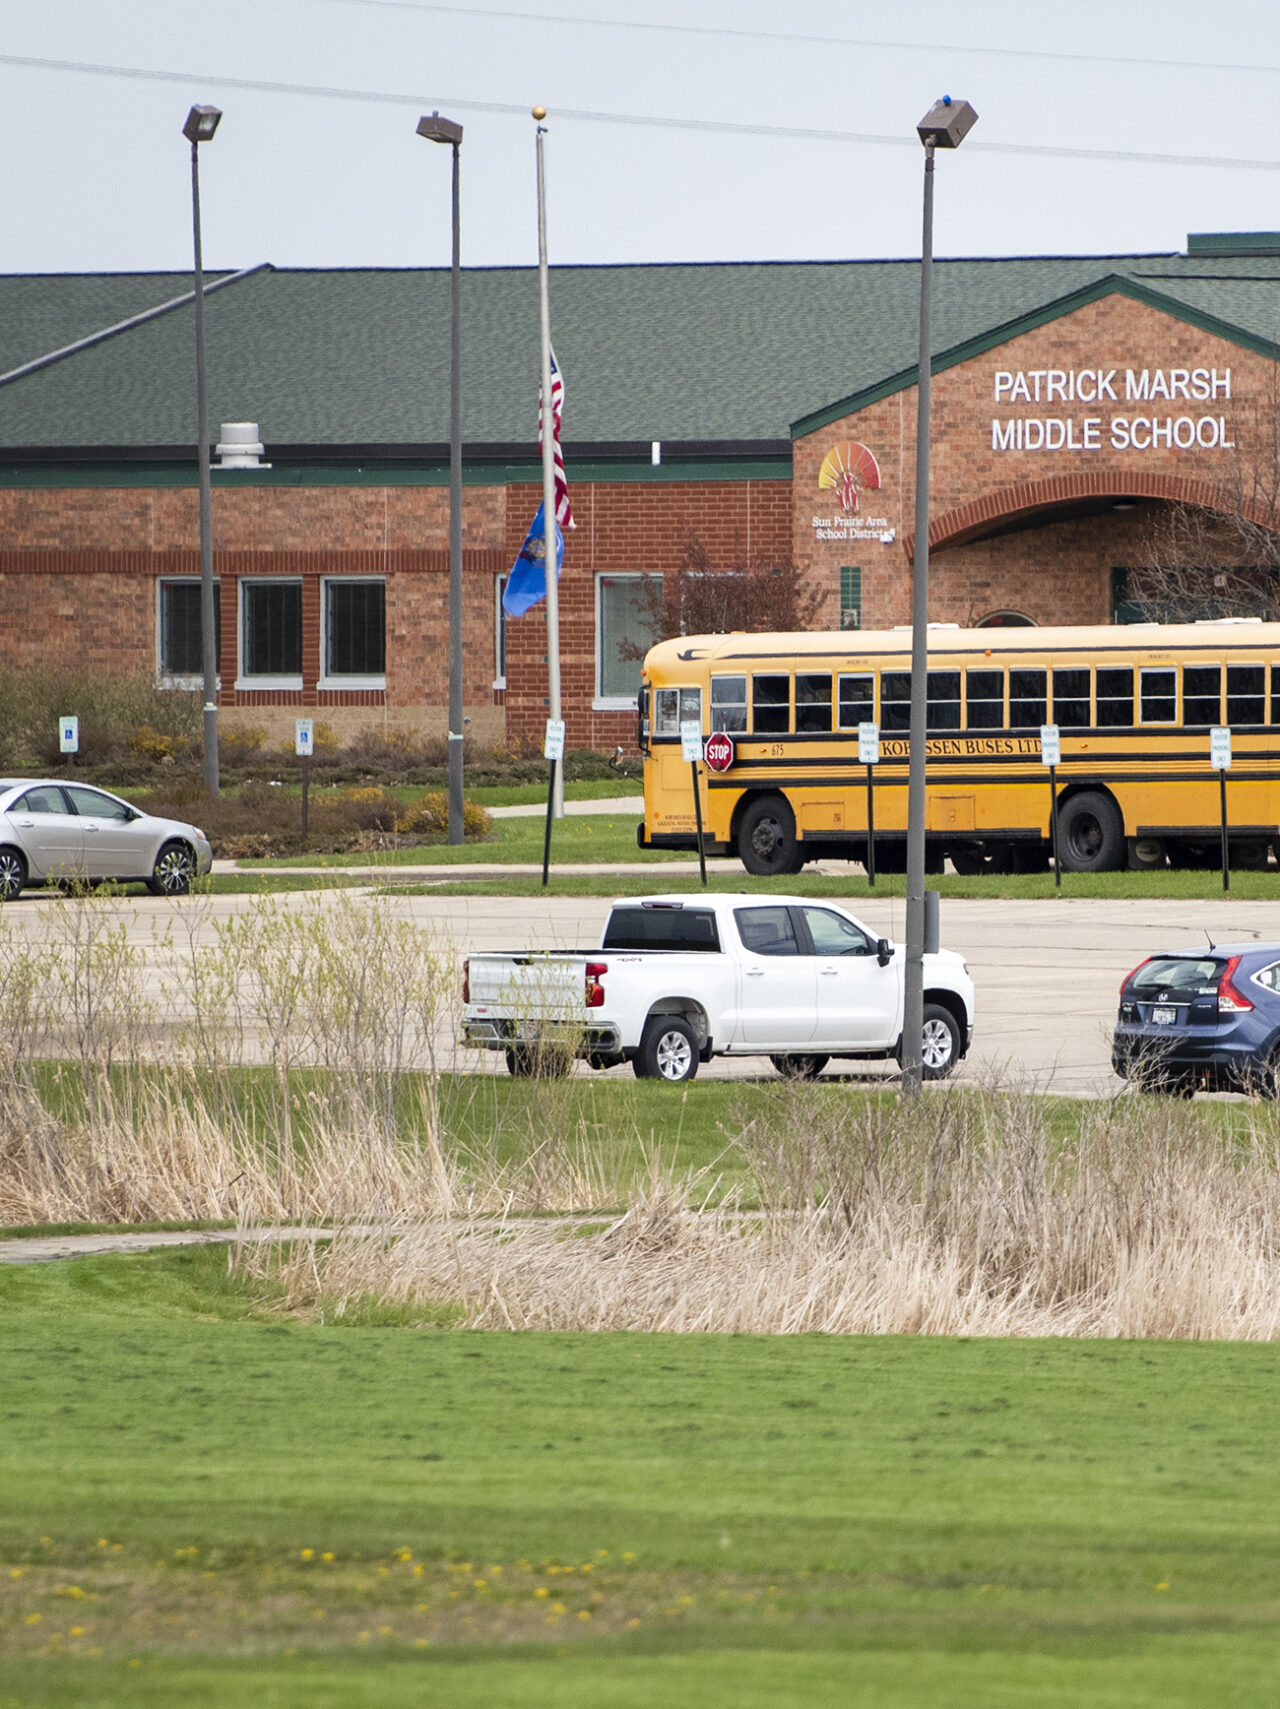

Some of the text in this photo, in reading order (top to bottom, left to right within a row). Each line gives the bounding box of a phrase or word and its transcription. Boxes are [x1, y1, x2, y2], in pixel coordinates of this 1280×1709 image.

[994, 368, 1231, 402] PATRICK MARSH
[992, 416, 1236, 450] MIDDLE SCHOOL
[812, 516, 887, 527] Sun Prairie Area
[816, 528, 847, 539] School
[709, 744, 730, 760] STOP
[771, 744, 784, 756] 675
[881, 740, 961, 756] KOBSSEN
[966, 739, 1014, 754] BUSES
